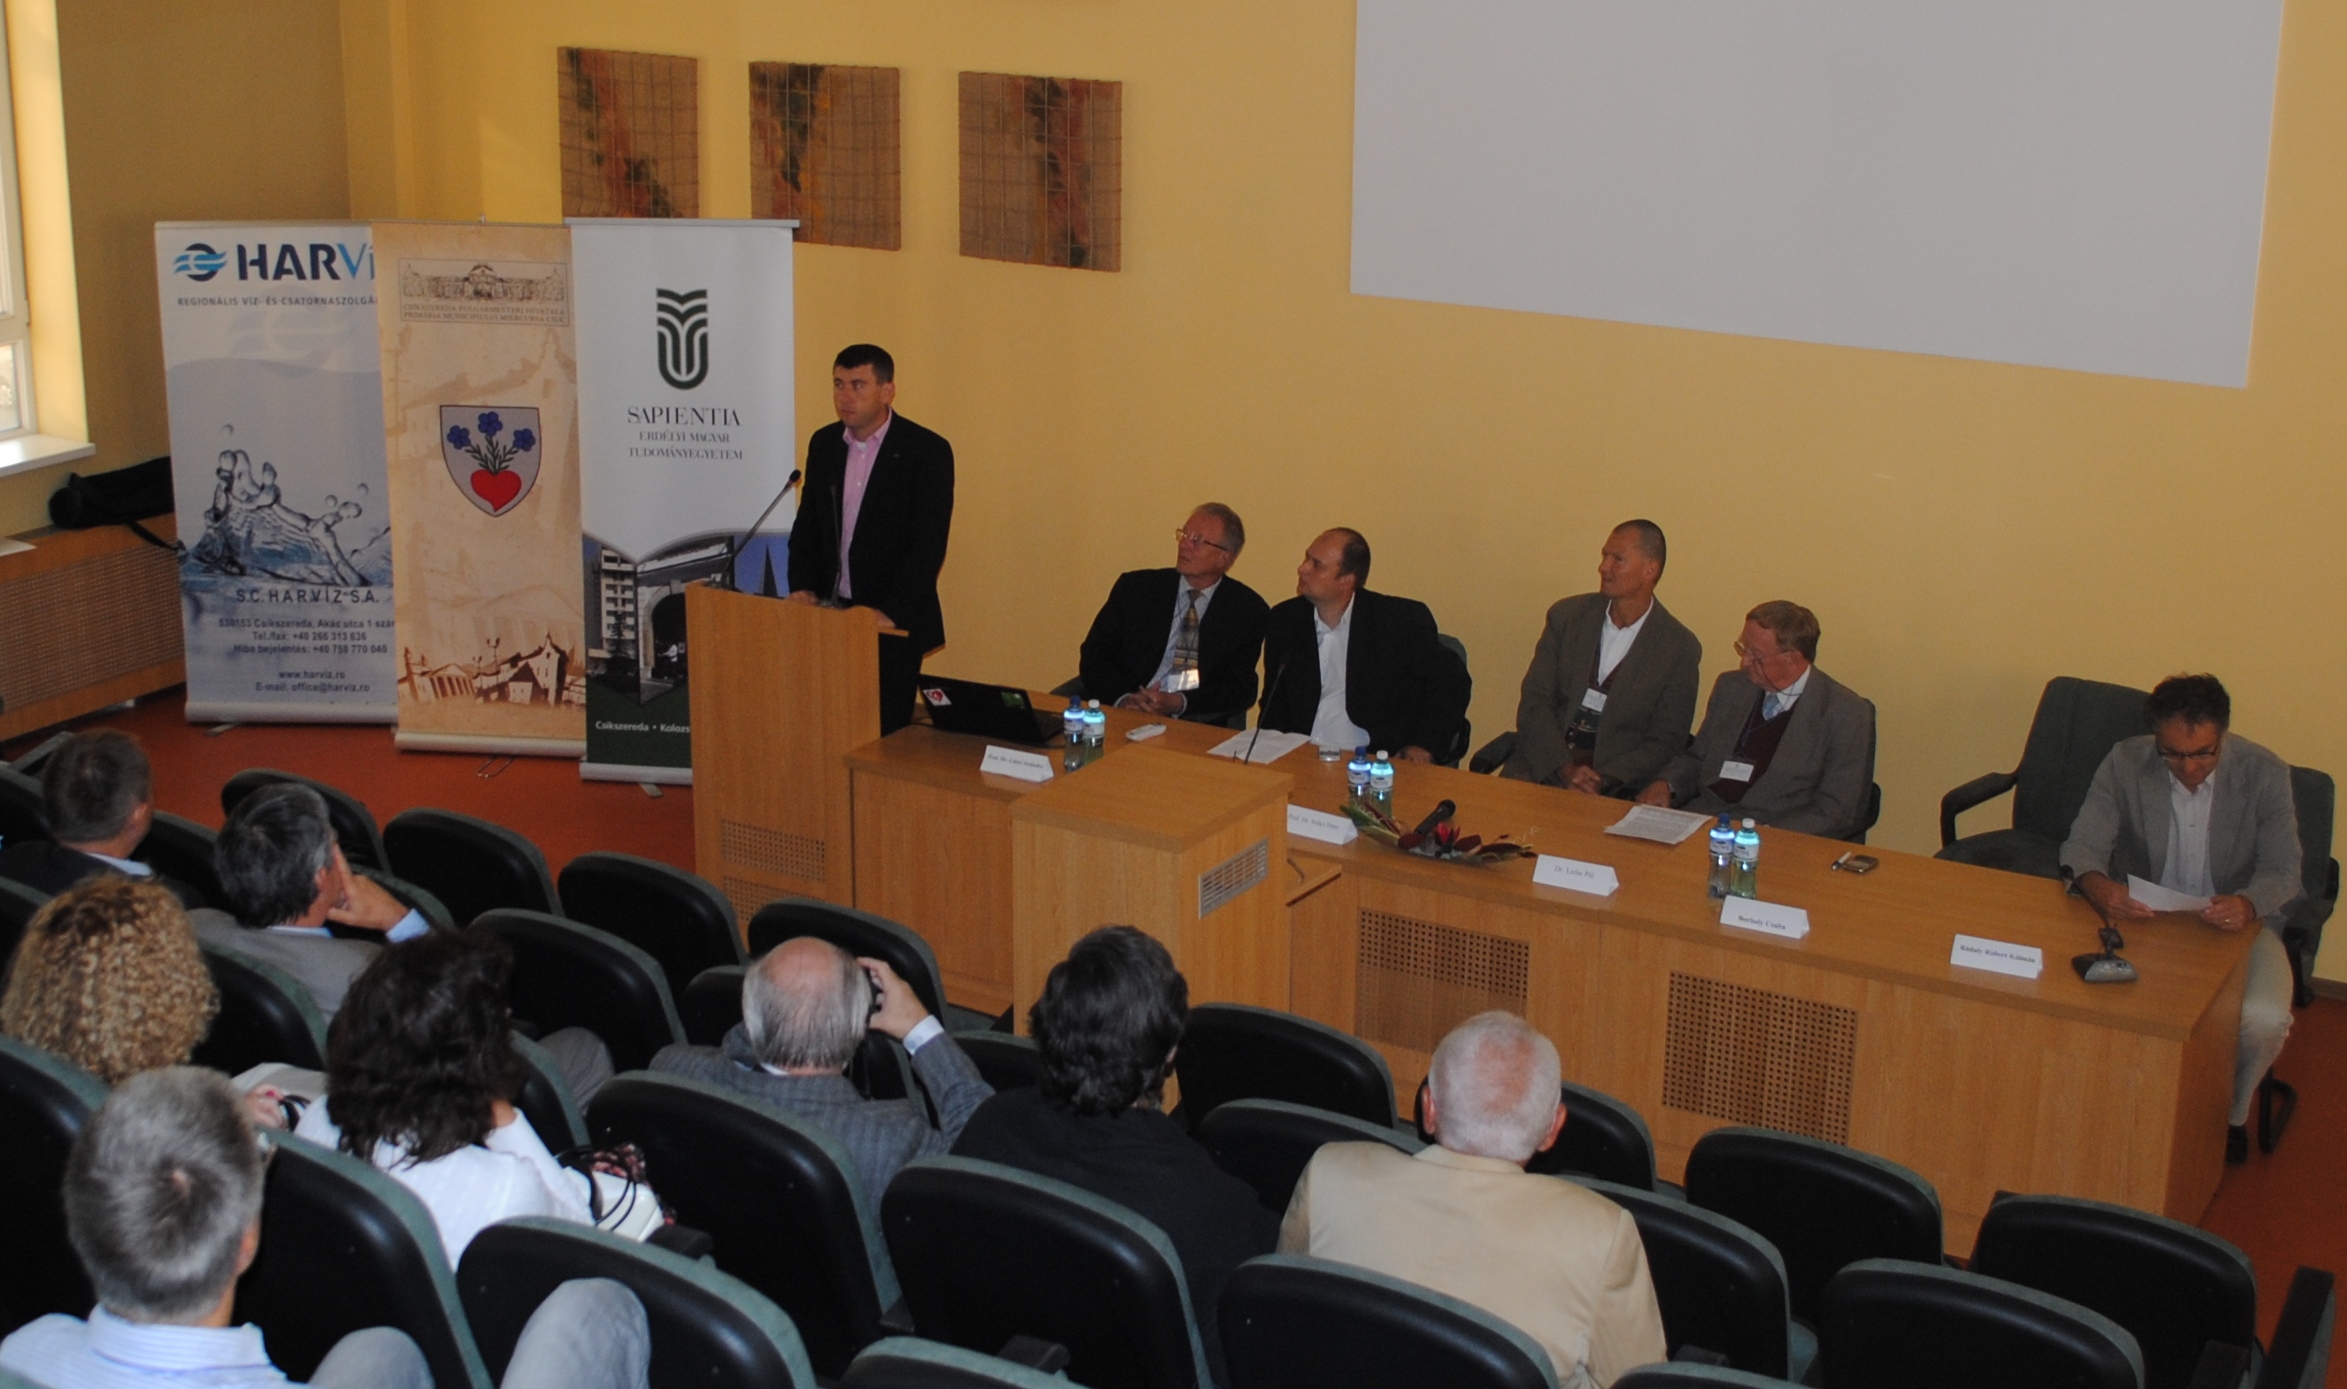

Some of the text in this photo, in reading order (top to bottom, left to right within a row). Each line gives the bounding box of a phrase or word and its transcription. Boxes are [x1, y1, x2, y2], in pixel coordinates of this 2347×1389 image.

[178, 295, 238, 306] REGIONÁLIS
[266, 296, 277, 306] ÉS
[627, 405, 741, 427] SAPIENTIA
[639, 430, 730, 443] ERDÉLYI MAGYAR
[628, 446, 743, 460] TUDOMÁNYEGYETEM
[236, 590, 264, 603] S.C.
[350, 590, 380, 603] S.A.
[293, 632, 310, 641] +40
[313, 644, 330, 654] +40
